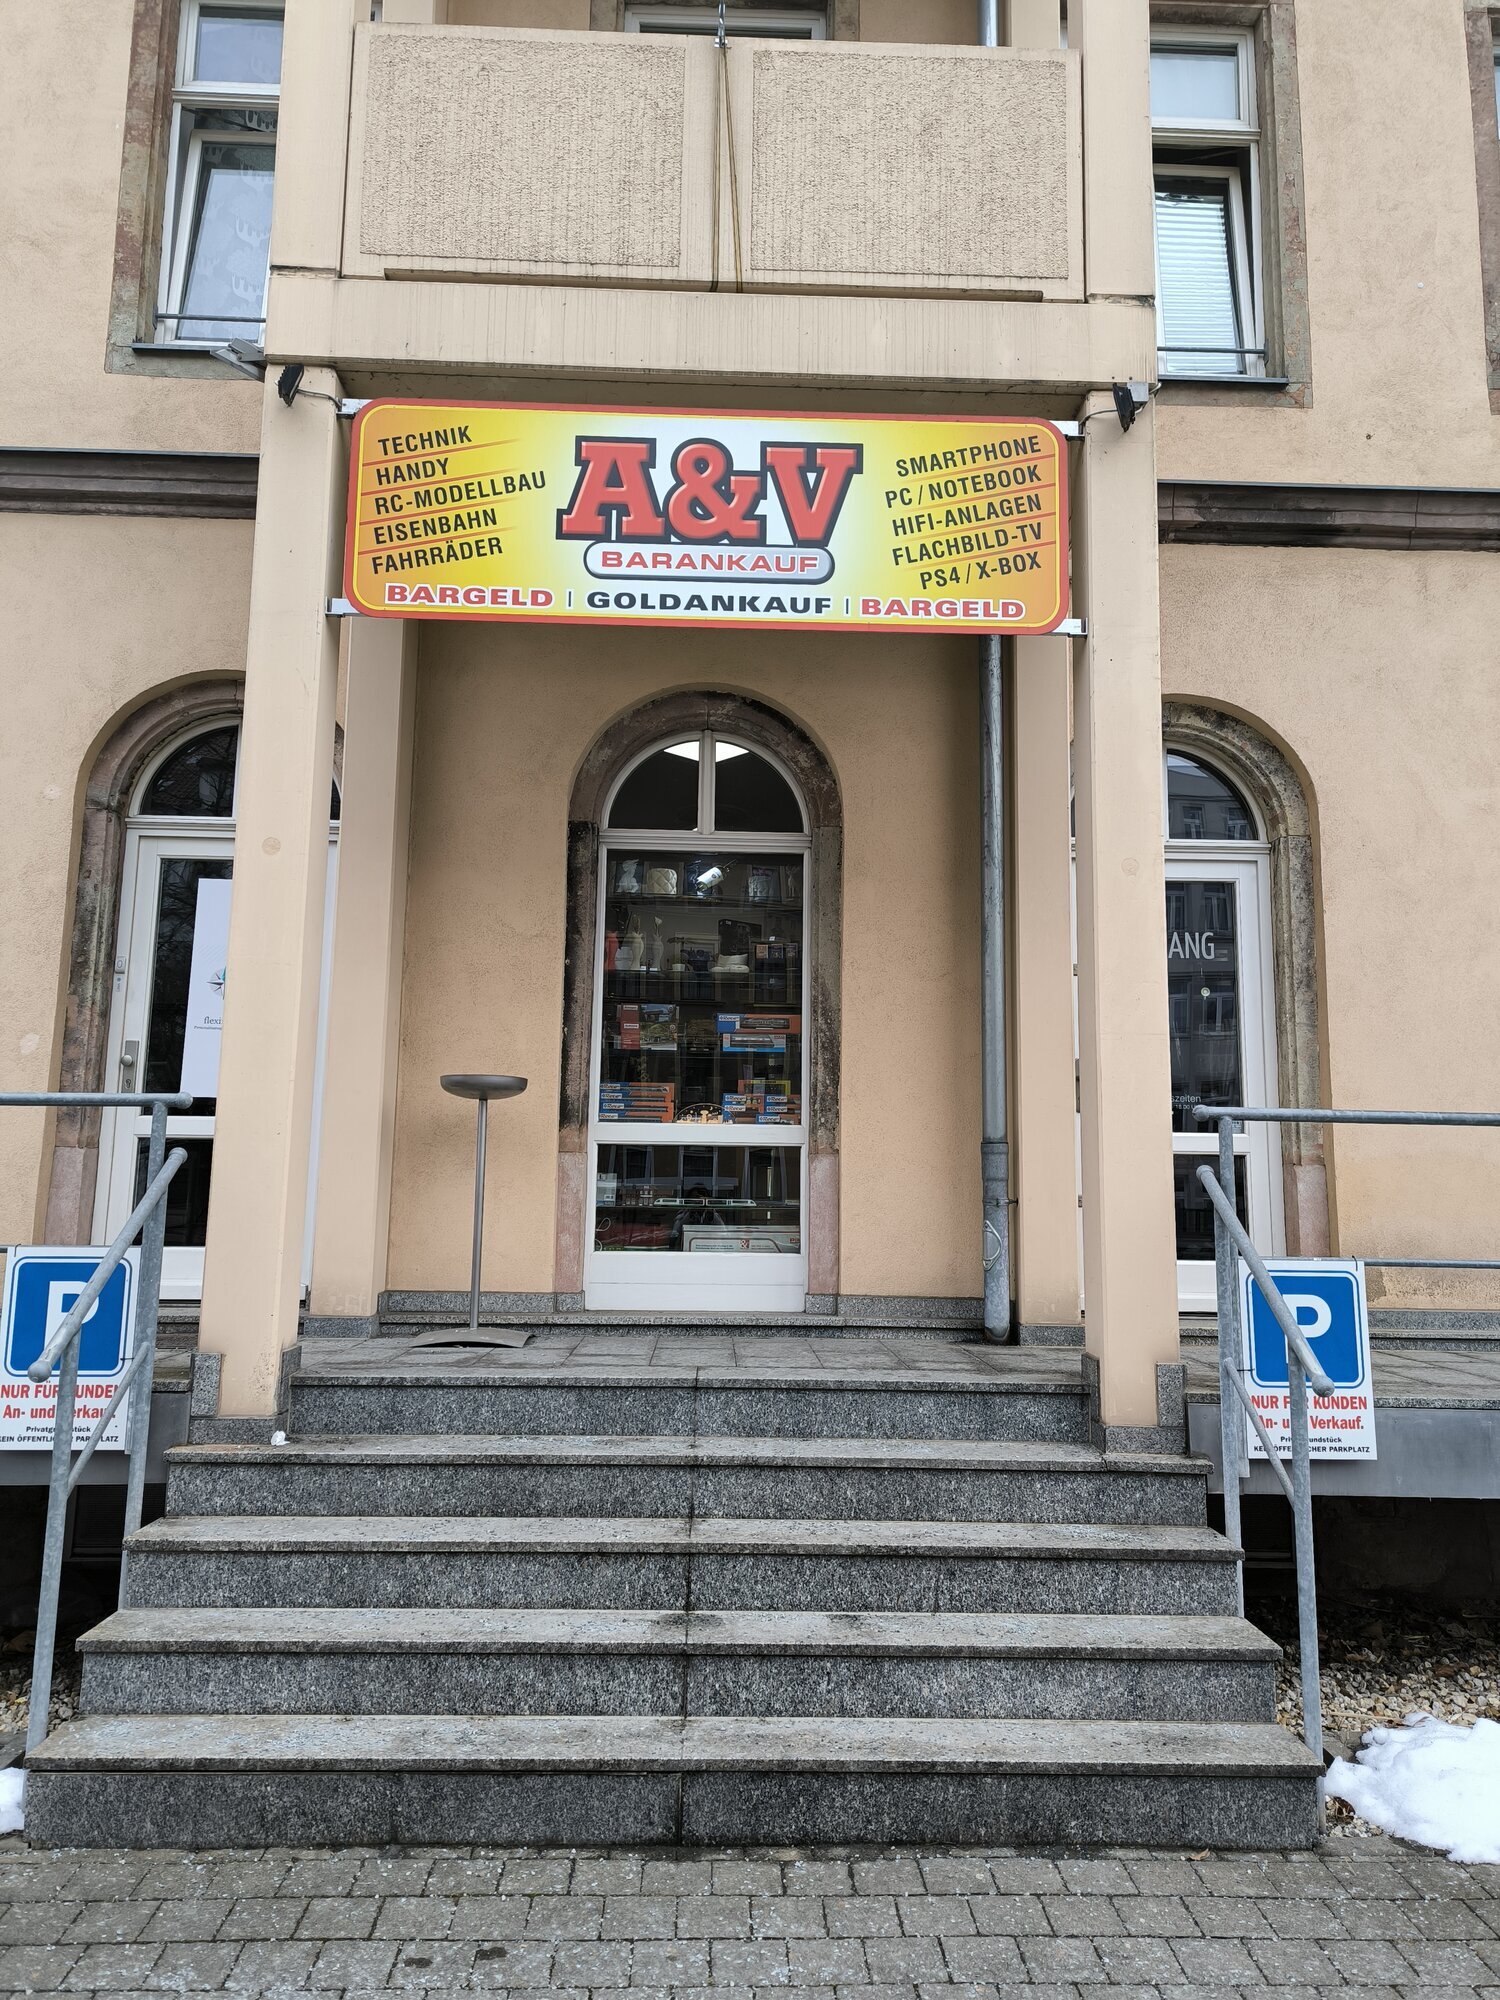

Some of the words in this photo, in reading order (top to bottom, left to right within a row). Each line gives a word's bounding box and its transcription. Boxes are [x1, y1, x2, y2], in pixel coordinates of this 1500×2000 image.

[378, 425, 472, 457] TECHNIK
[896, 435, 1041, 477] SMARTPHONE
[376, 457, 449, 486] HANDY
[885, 487, 913, 509] PC
[928, 465, 1041, 501] NOTEBOOK
[374, 470, 546, 515] RC-MODELLBAU
[556, 435, 864, 547] A&V
[373, 508, 498, 545] EISENBAHN
[892, 493, 1042, 537] HIFI-ANLAGEN
[371, 536, 503, 575] FAHRRÄDER
[600, 551, 819, 573] BARANKAUF
[892, 522, 1042, 566] FLACHBILD-TV
[919, 568, 961, 590] PS4
[977, 551, 1042, 580] X-BOX
[386, 584, 554, 608] BARGELD
[587, 591, 832, 614] GOLDANKAUF
[861, 598, 1025, 619] BARGELD
[1, 1384, 30, 1398] NUR
[74, 1384, 119, 1398] UNDE
[1251, 1395, 1279, 1409] NUR
[1314, 1396, 1367, 1410] KUNDEN
[3, 1405, 25, 1418] An-
[30, 1404, 56, 1418] und
[1310, 1415, 1364, 1430] Verkauf.
